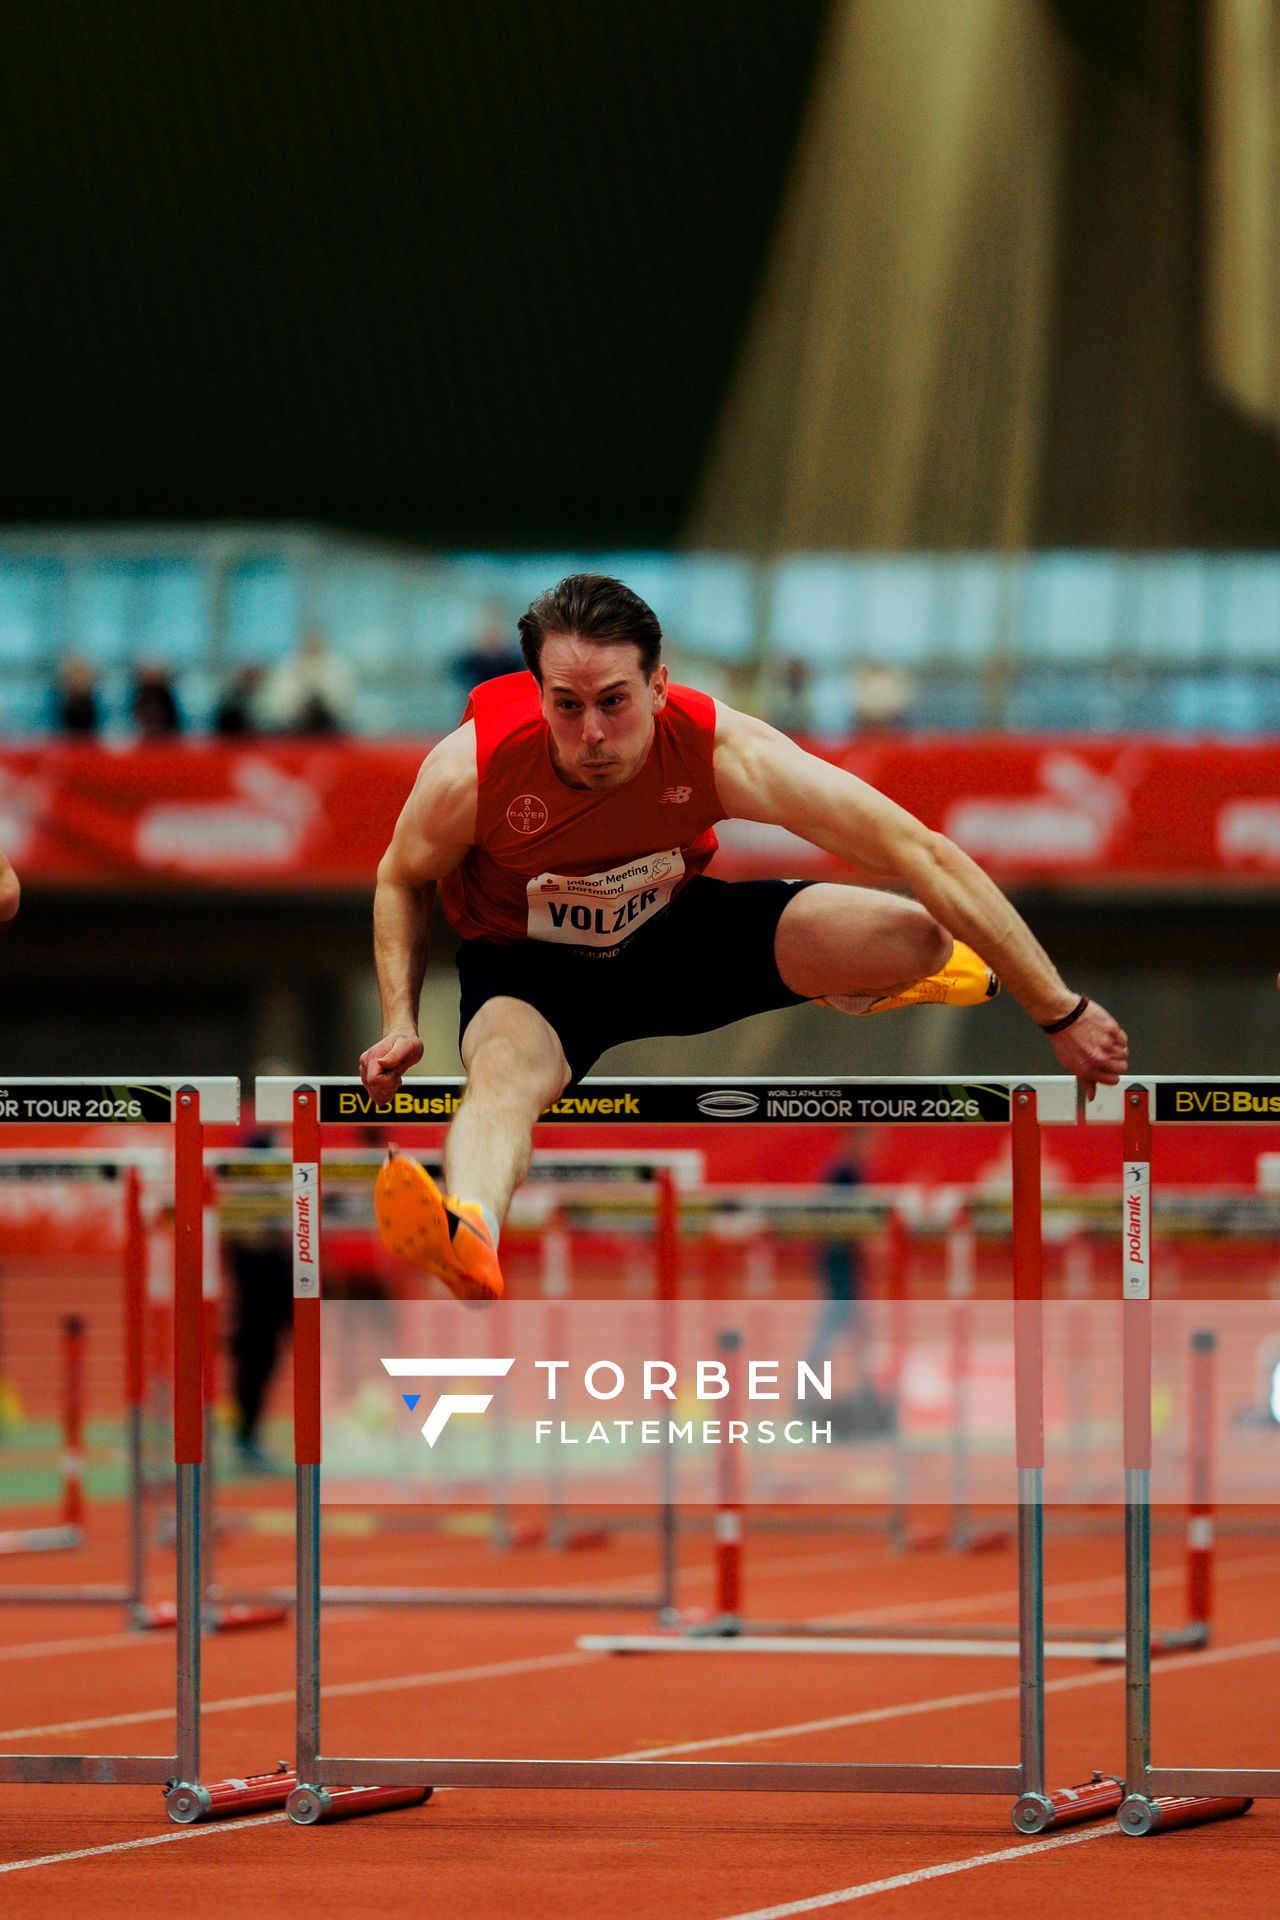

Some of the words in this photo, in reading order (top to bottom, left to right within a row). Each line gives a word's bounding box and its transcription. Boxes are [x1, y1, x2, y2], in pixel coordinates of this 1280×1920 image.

[567, 879, 603, 887] Indoor
[606, 864, 648, 885] Meeting
[567, 884, 624, 896] Dortmund
[548, 887, 660, 935] VOLZER
[23, 1099, 81, 1118] TOUR
[85, 1099, 142, 1118] 2026
[767, 1100, 852, 1117] INDOOR
[857, 1100, 917, 1117] TOUR
[921, 1100, 980, 1117] 2026
[296, 1193, 314, 1265] polanik
[1127, 1193, 1145, 1265] polanik
